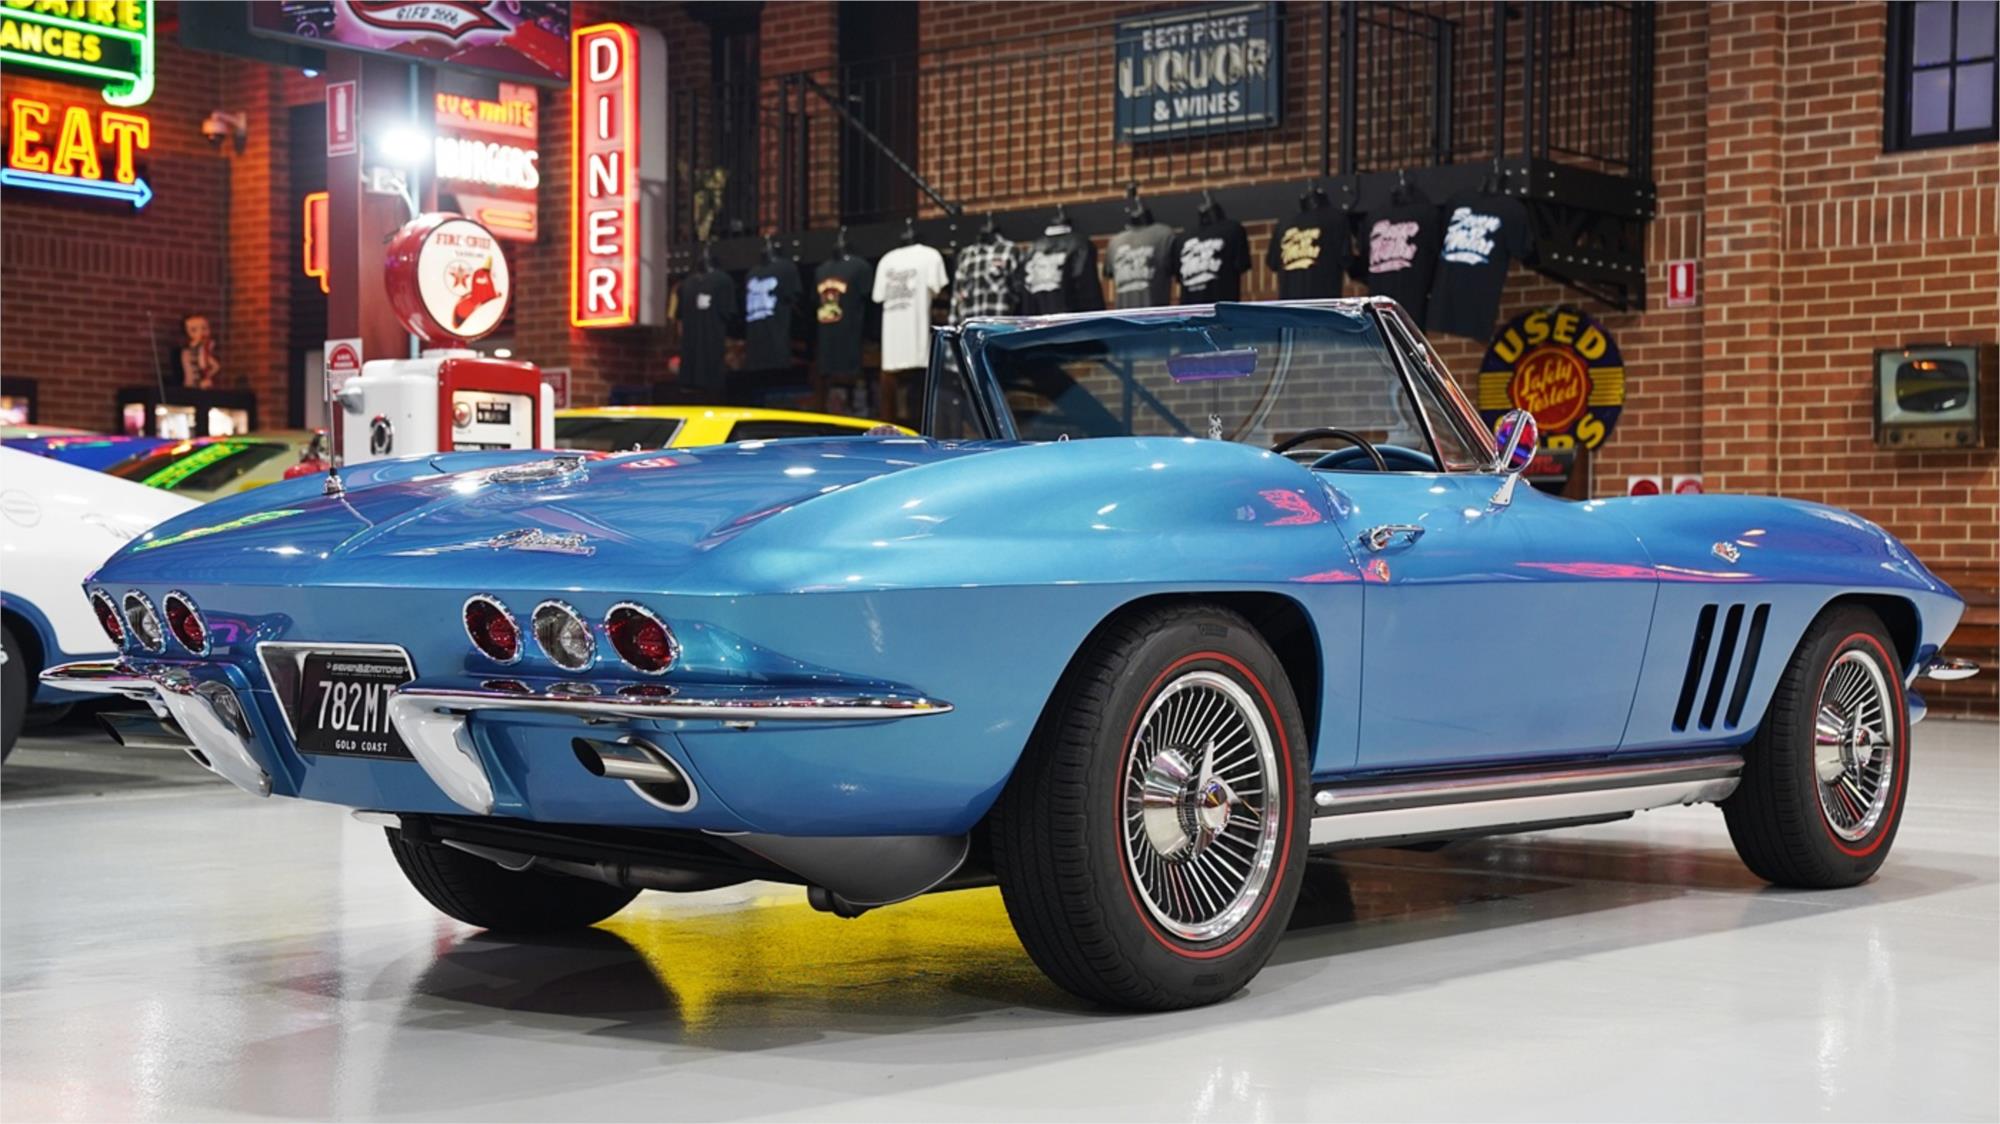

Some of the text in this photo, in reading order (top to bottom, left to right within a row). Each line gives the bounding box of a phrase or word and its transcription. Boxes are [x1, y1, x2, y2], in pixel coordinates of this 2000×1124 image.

[0, 20, 102, 62] ANCES
[1119, 38, 1268, 98] LIQUOR
[1153, 91, 1240, 121] & WINES
[11, 98, 149, 184] EAT
[588, 37, 619, 312] DINER
[1494, 312, 1607, 363] USED
[1527, 378, 1579, 413] Tested
[335, 739, 388, 753] GOLD COAST
